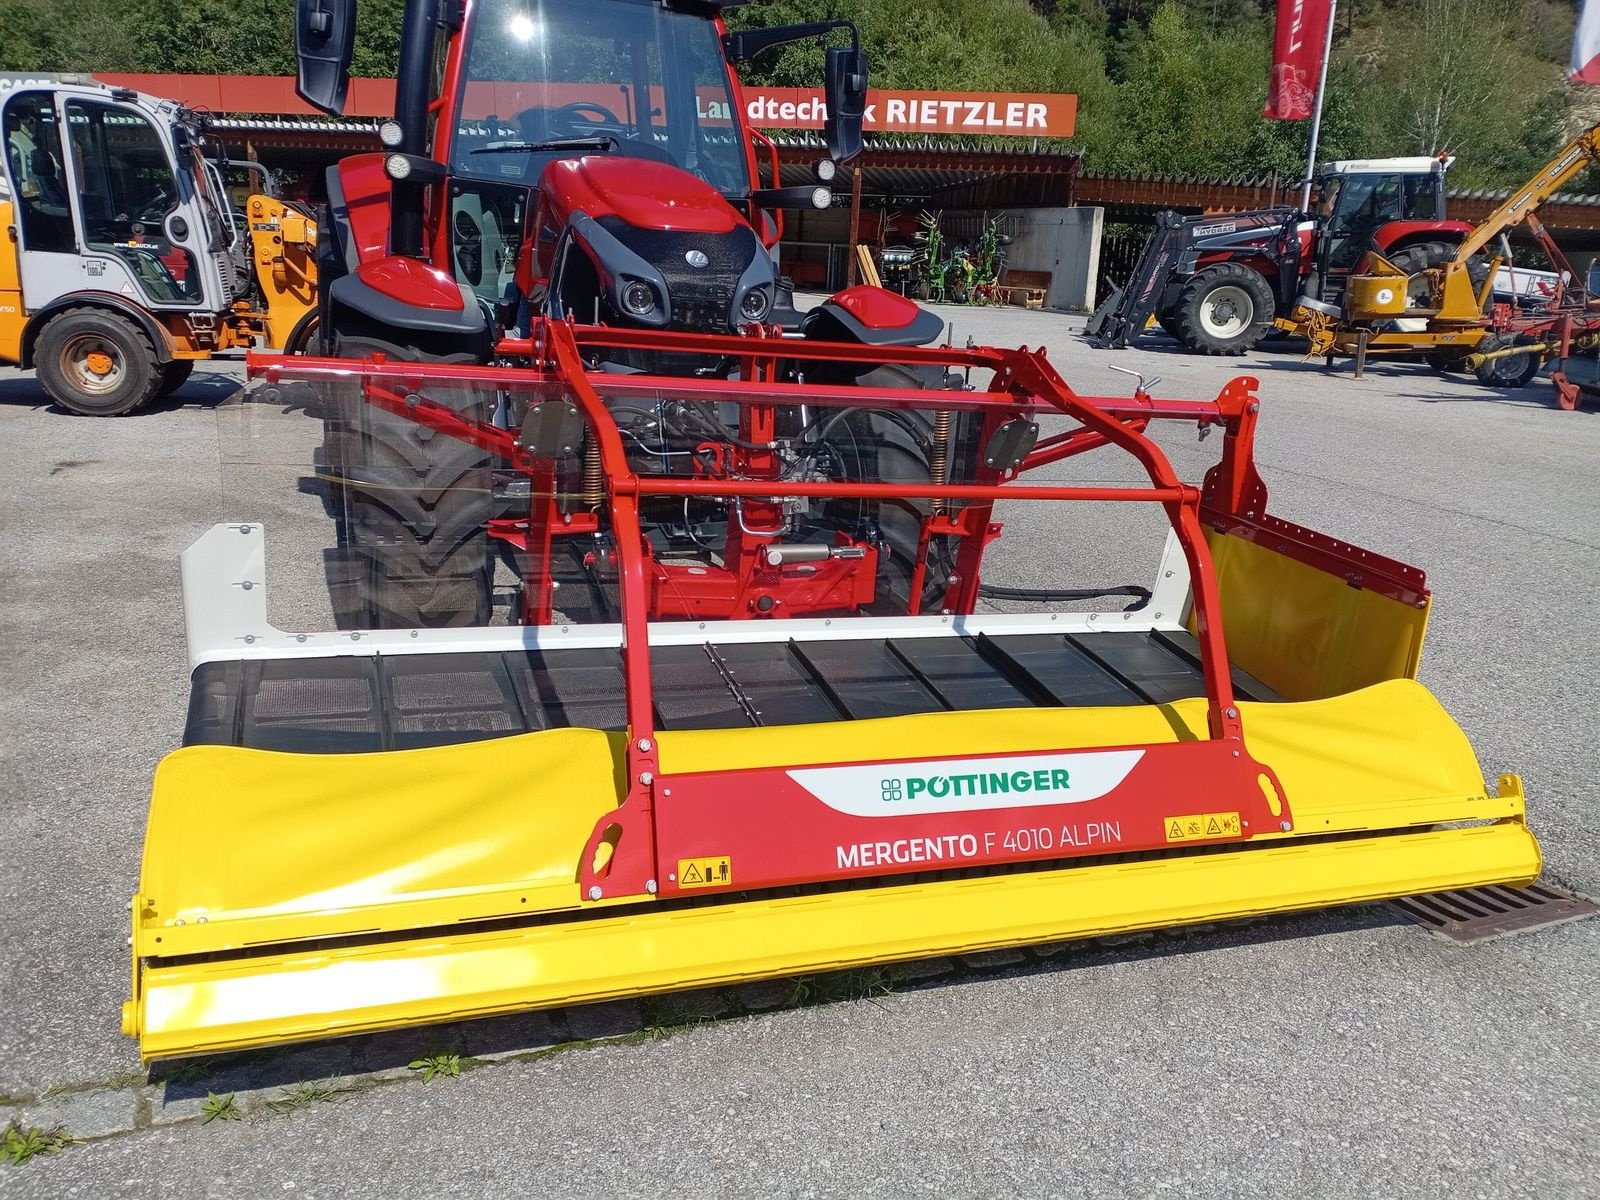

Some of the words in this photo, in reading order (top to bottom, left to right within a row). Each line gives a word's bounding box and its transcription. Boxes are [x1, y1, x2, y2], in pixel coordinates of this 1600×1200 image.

[886, 99, 1048, 127] RIETZLER
[1200, 226, 1234, 235] HYDRAC
[836, 834, 978, 869] MERGENTO
[985, 832, 997, 855] F
[1003, 827, 1054, 853] 4010
[1059, 821, 1122, 848] ALPIN
